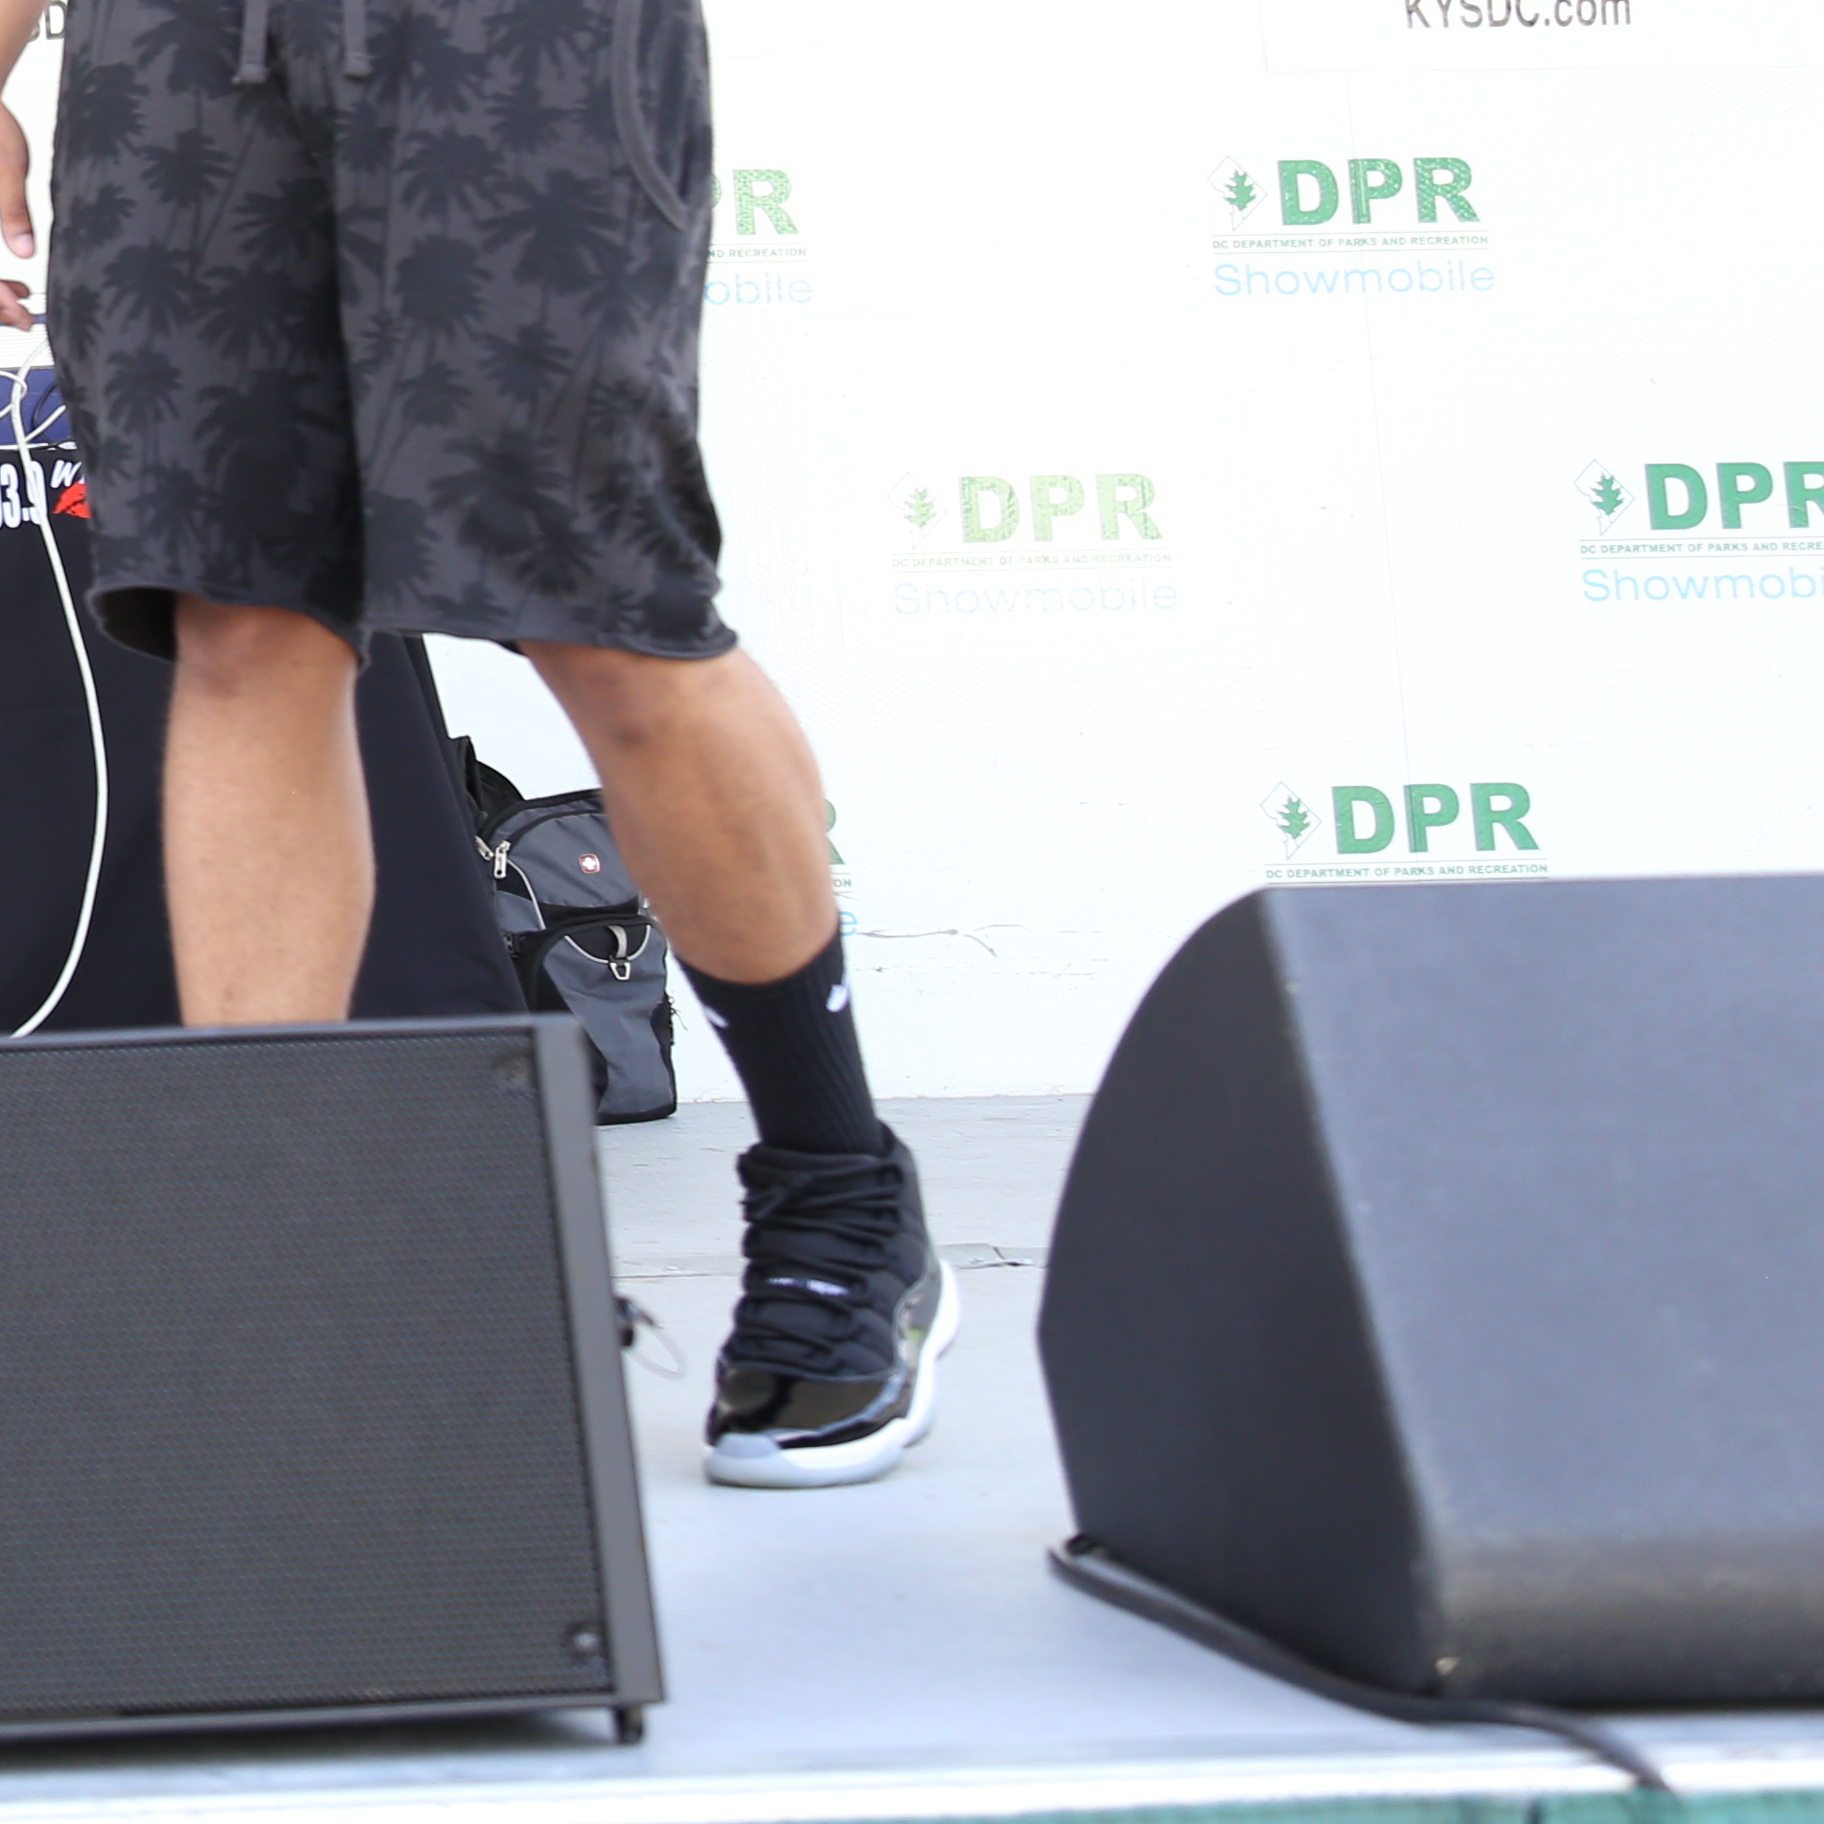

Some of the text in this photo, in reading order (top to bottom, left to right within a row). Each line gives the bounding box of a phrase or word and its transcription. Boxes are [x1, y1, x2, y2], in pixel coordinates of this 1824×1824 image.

[1277, 157, 1481, 226] DPR
[707, 248, 807, 259] ND RECREATION
[1212, 235, 1489, 249] DC DEPARTMENT OF PARKS AND RECREATION
[704, 271, 813, 306] obile
[1214, 259, 1495, 296] Showmobile
[959, 473, 1163, 544] DPR
[1644, 461, 1824, 530] DPR
[892, 553, 1171, 568] DC DEPARTMENT OF PARKS AND RECREATION
[1580, 541, 1824, 554] DC DEPARTMENT OF PARKS AND RECRE
[894, 579, 1178, 615] Showmobile
[1582, 566, 1824, 602] Showmobi
[1331, 782, 1540, 854] DPR
[1266, 864, 1548, 879] DC DEPARTMENT OF PARKS AND RECREATION
